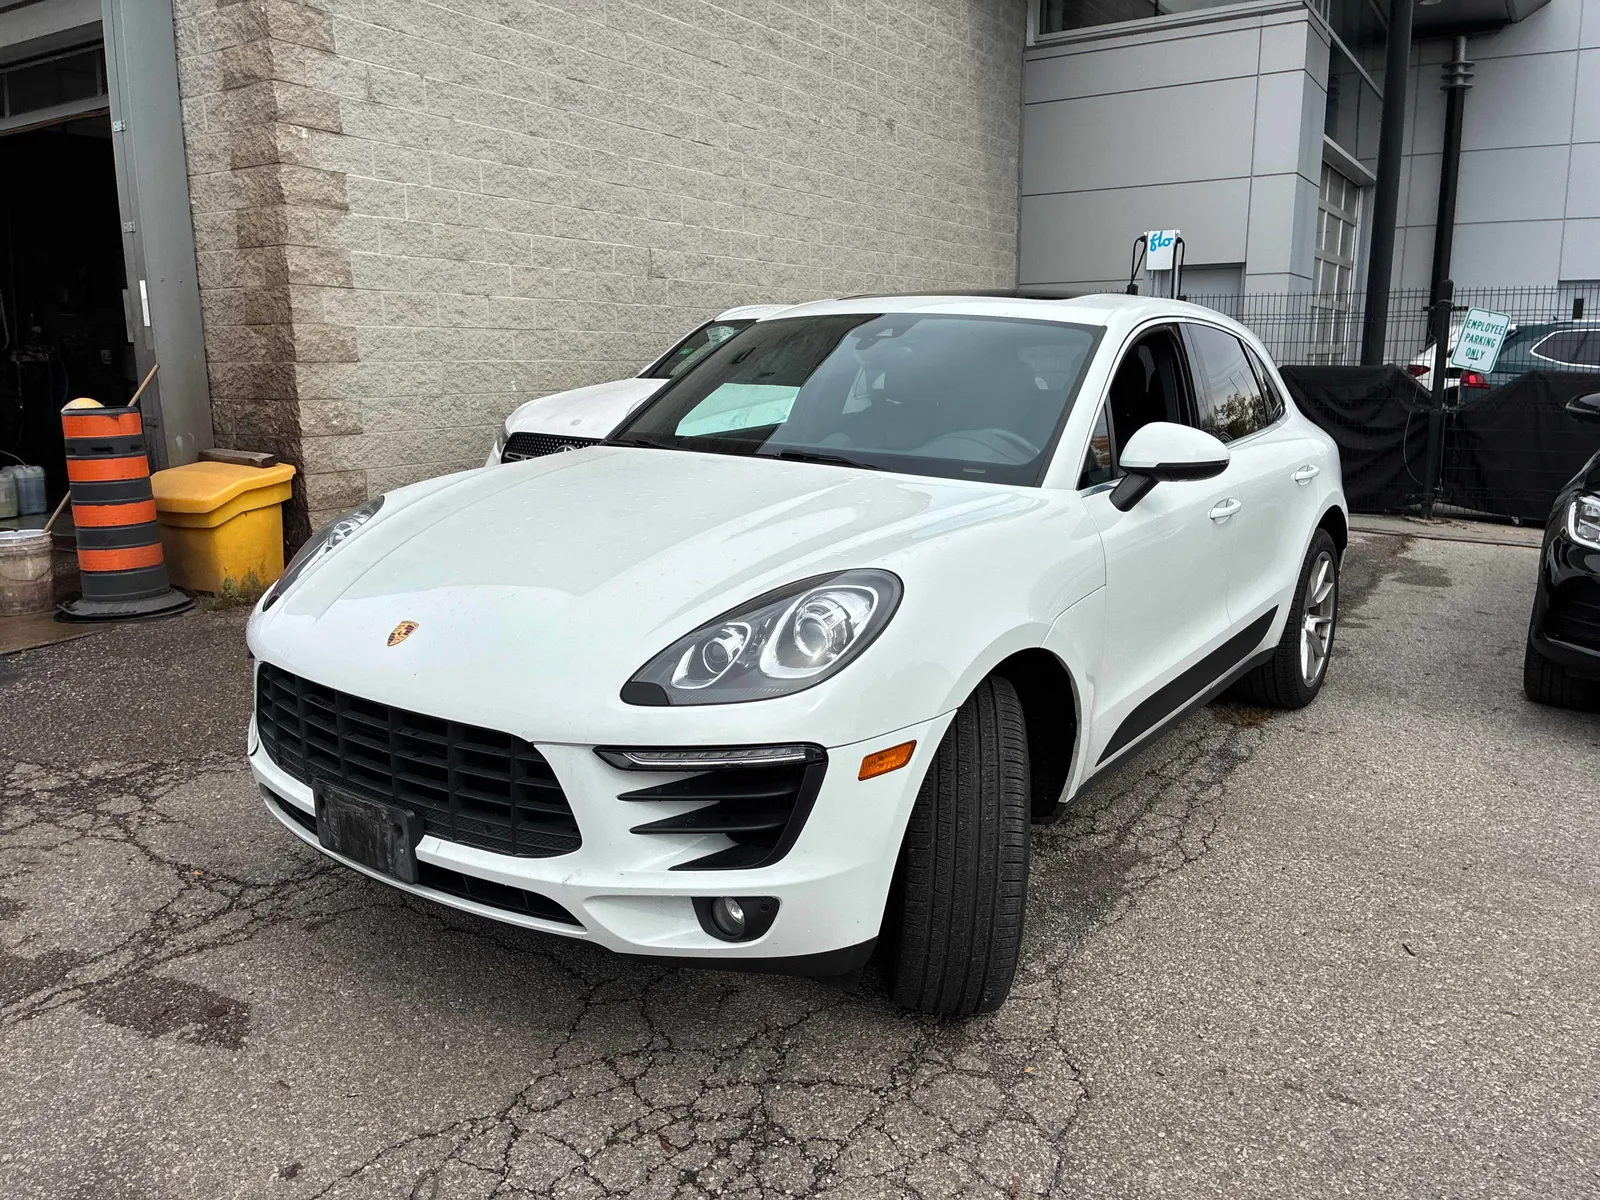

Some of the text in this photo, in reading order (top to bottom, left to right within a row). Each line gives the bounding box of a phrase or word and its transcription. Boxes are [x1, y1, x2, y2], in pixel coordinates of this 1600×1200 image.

[1150, 230, 1173, 251] flo
[1466, 319, 1504, 335] EMPLOYEE
[1464, 333, 1496, 348] PARKING
[1465, 347, 1486, 360] ONLY
